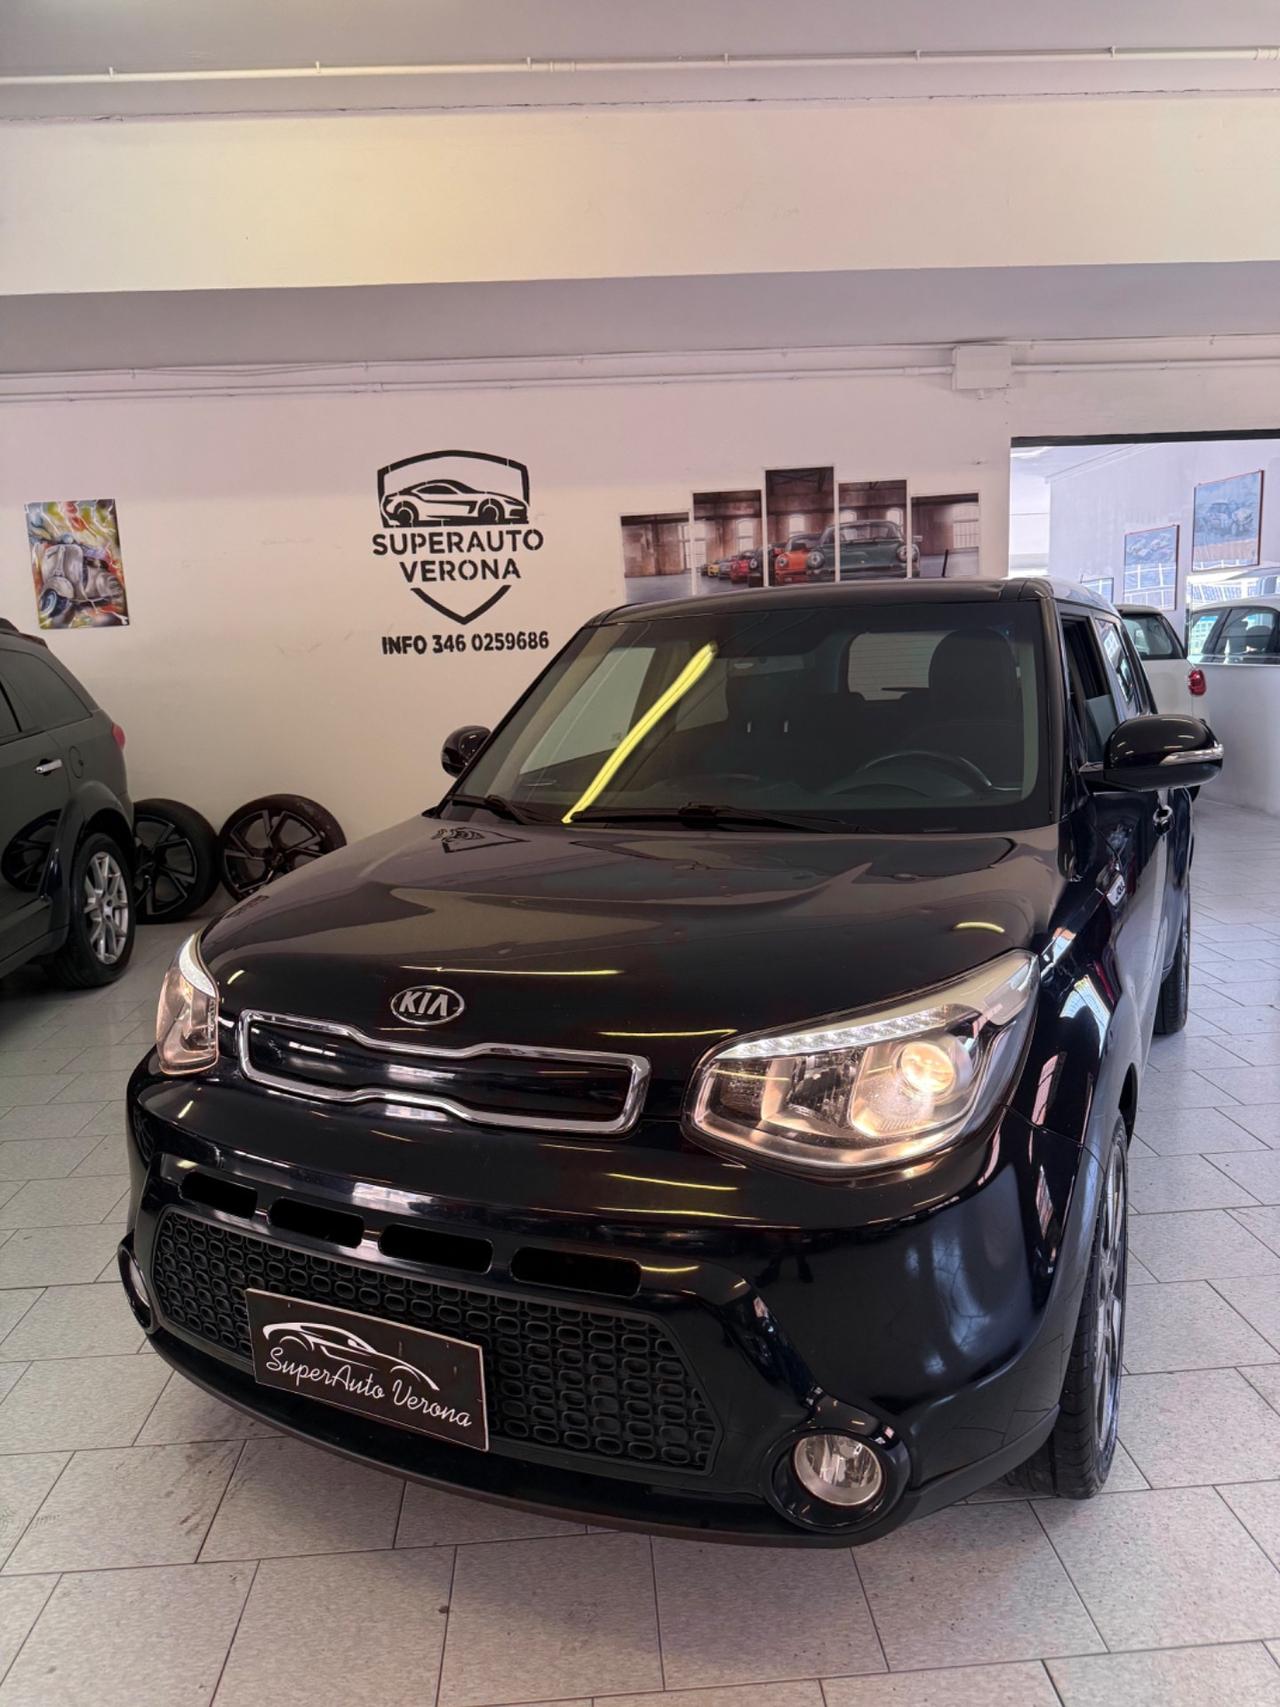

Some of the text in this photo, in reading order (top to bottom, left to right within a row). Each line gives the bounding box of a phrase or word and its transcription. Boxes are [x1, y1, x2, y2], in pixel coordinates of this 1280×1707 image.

[372, 529, 544, 555] SUPERAUTO
[399, 558, 521, 583] VERONA
[381, 631, 549, 655] INFO 346 0259686
[398, 991, 449, 1017] KIA
[265, 1346, 473, 1428] SuperAuto Verona
